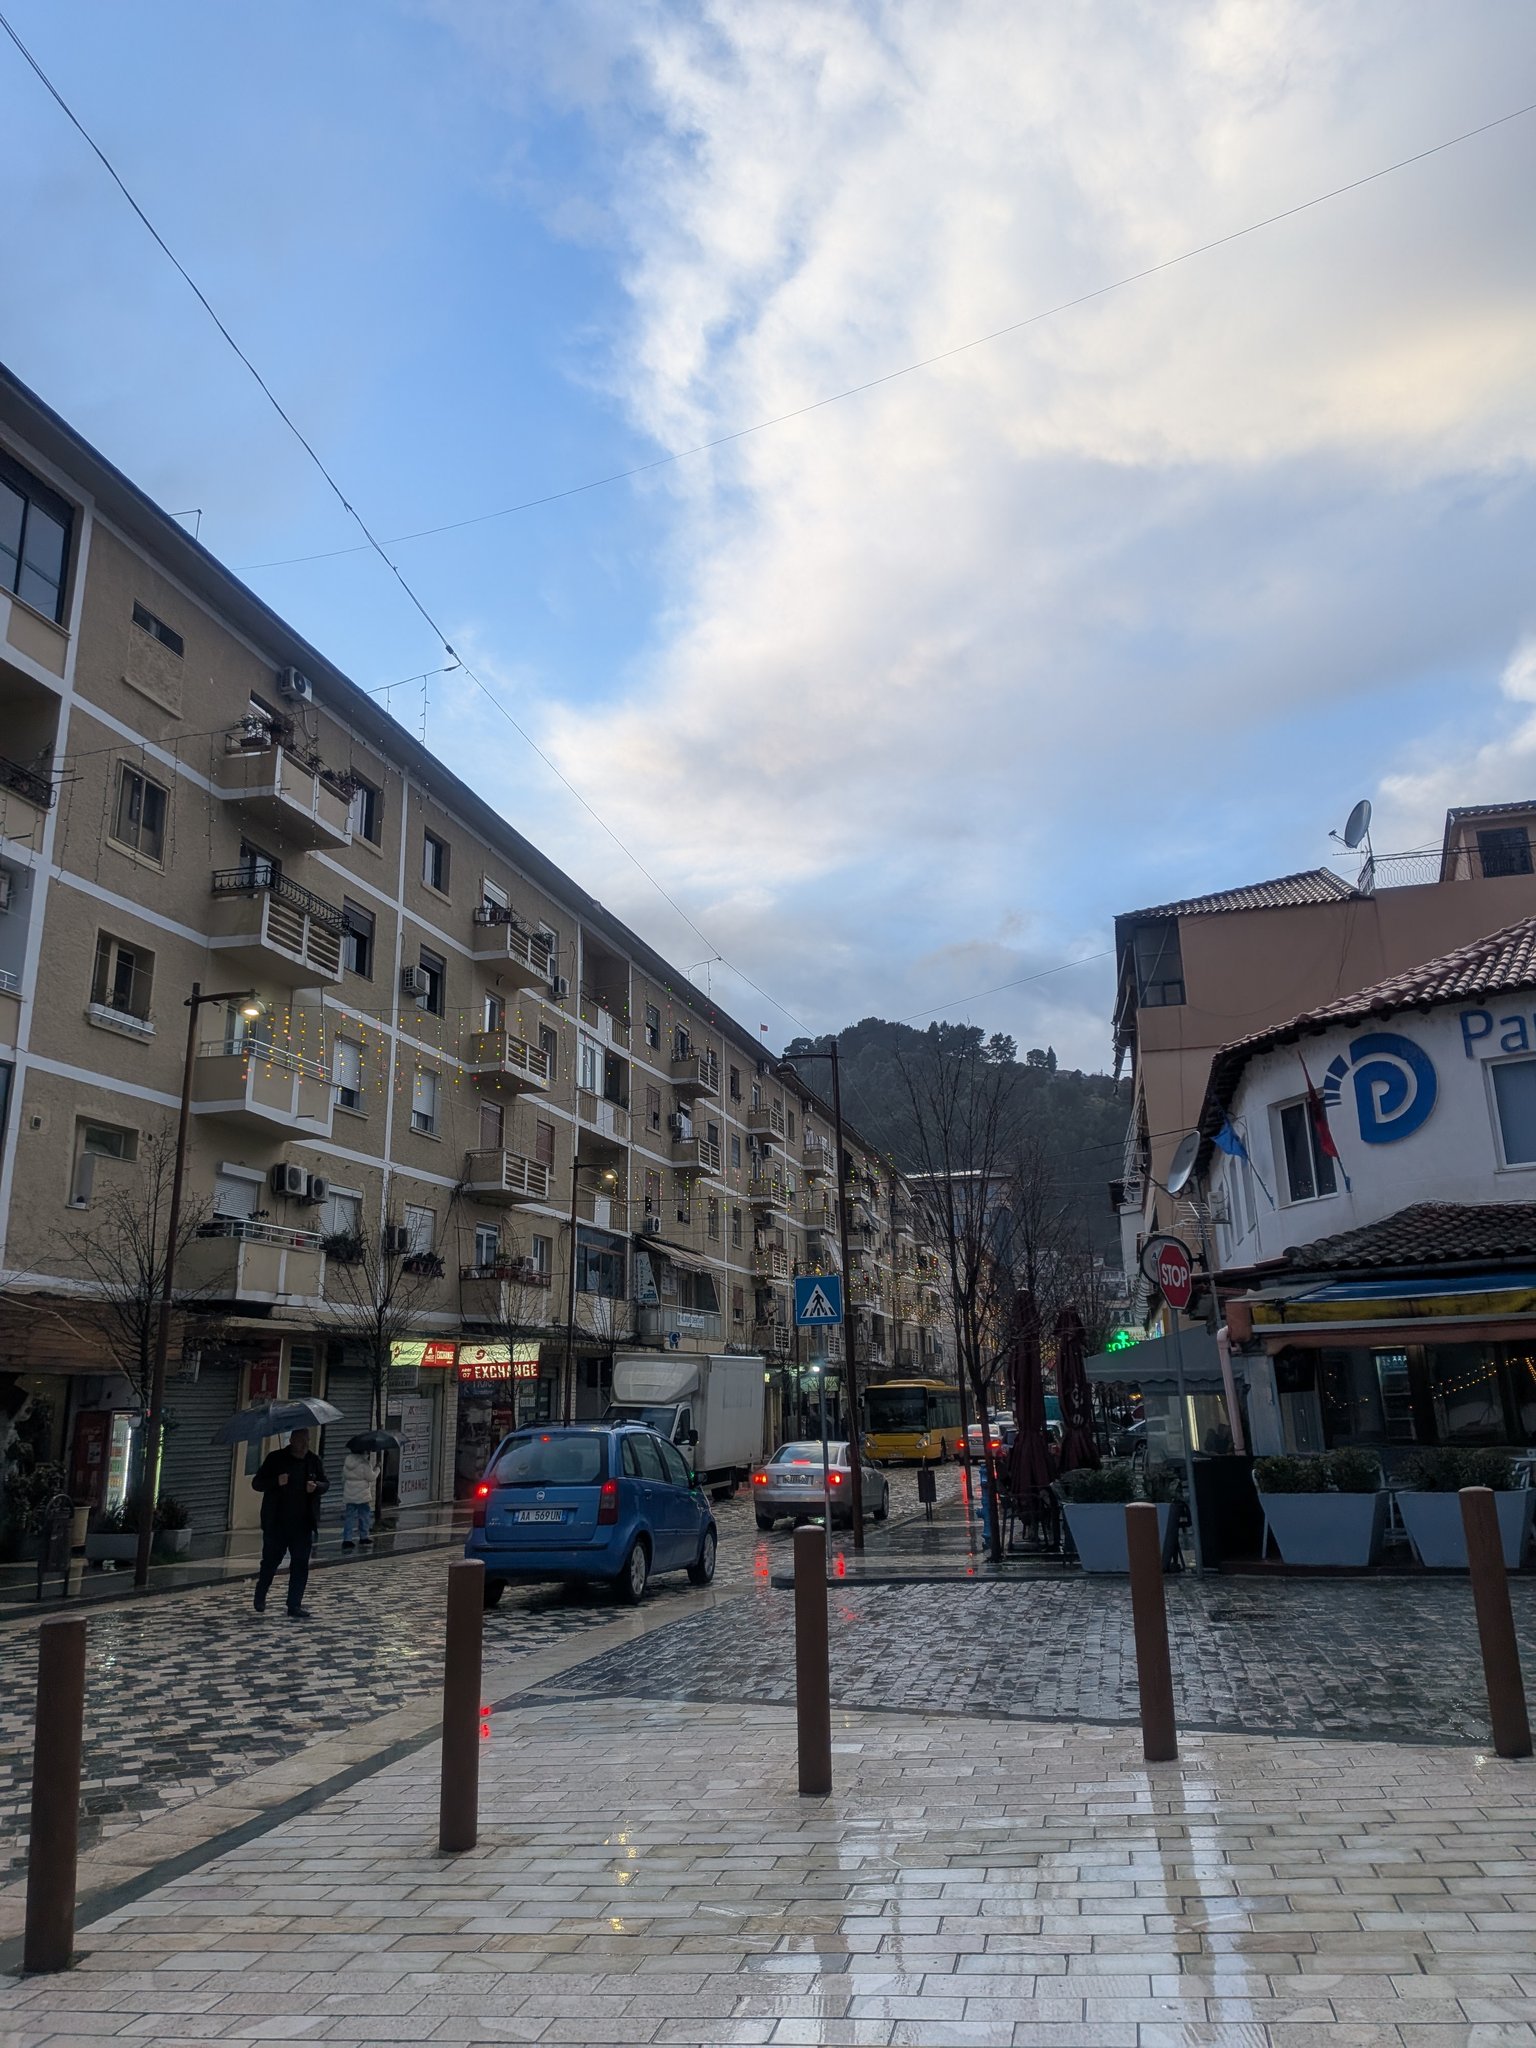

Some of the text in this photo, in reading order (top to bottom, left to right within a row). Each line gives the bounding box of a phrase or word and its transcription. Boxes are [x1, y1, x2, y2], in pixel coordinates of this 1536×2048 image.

[1459, 1009, 1536, 1059] Pa
[1161, 1263, 1188, 1288] STOP
[474, 1363, 538, 1379] EXCHANGE
[520, 1512, 530, 1521] AA
